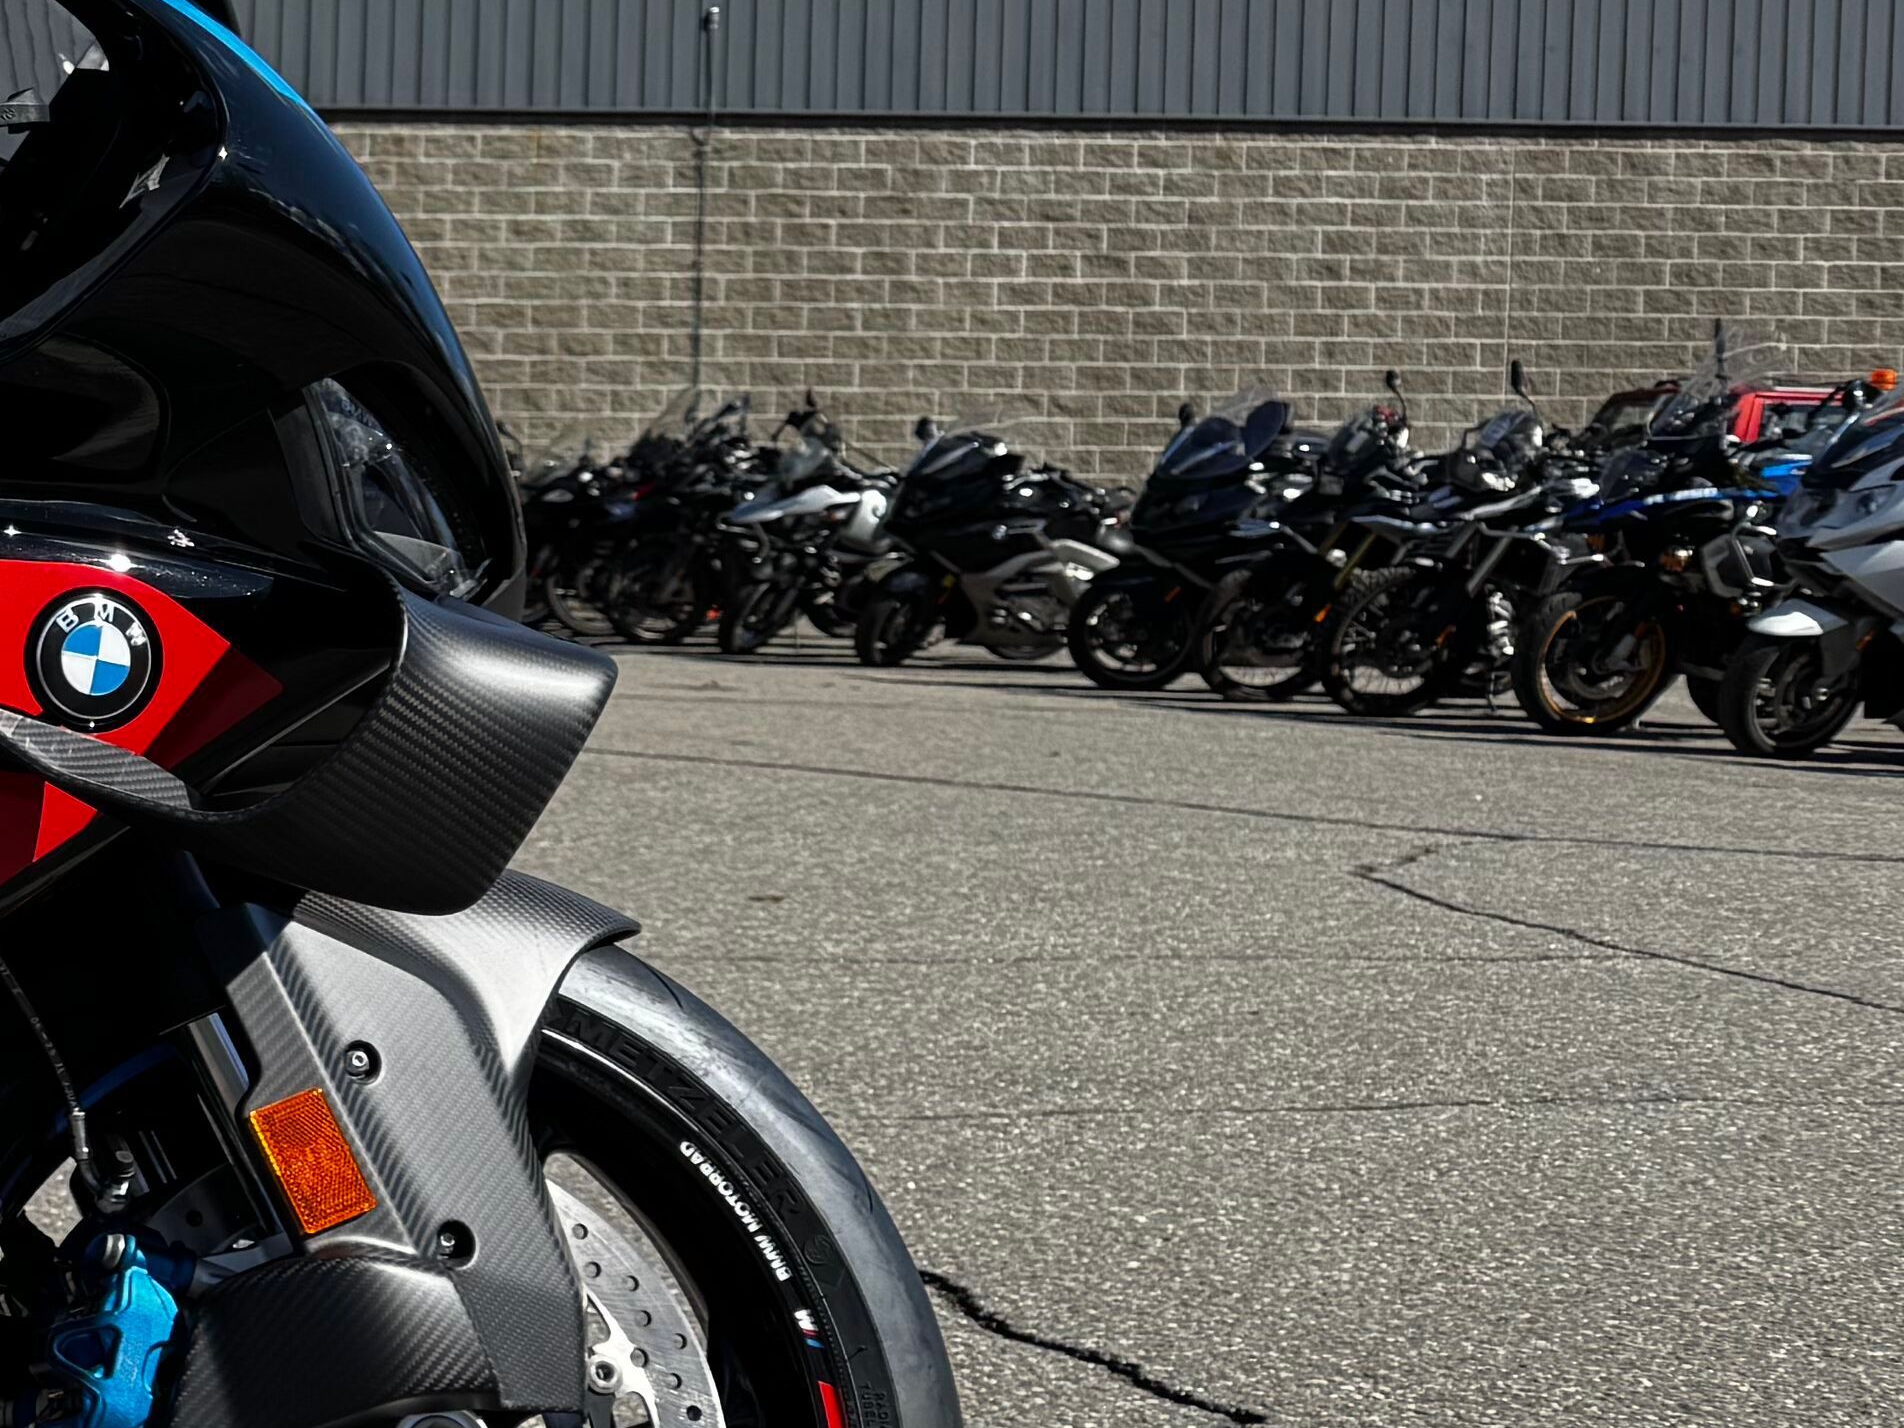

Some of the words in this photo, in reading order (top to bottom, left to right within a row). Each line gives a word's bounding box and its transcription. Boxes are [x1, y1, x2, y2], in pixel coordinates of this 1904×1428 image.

[55, 599, 148, 647] BMW
[679, 1140, 764, 1234] MOTORRAD
[754, 1233, 793, 1282] BMW
